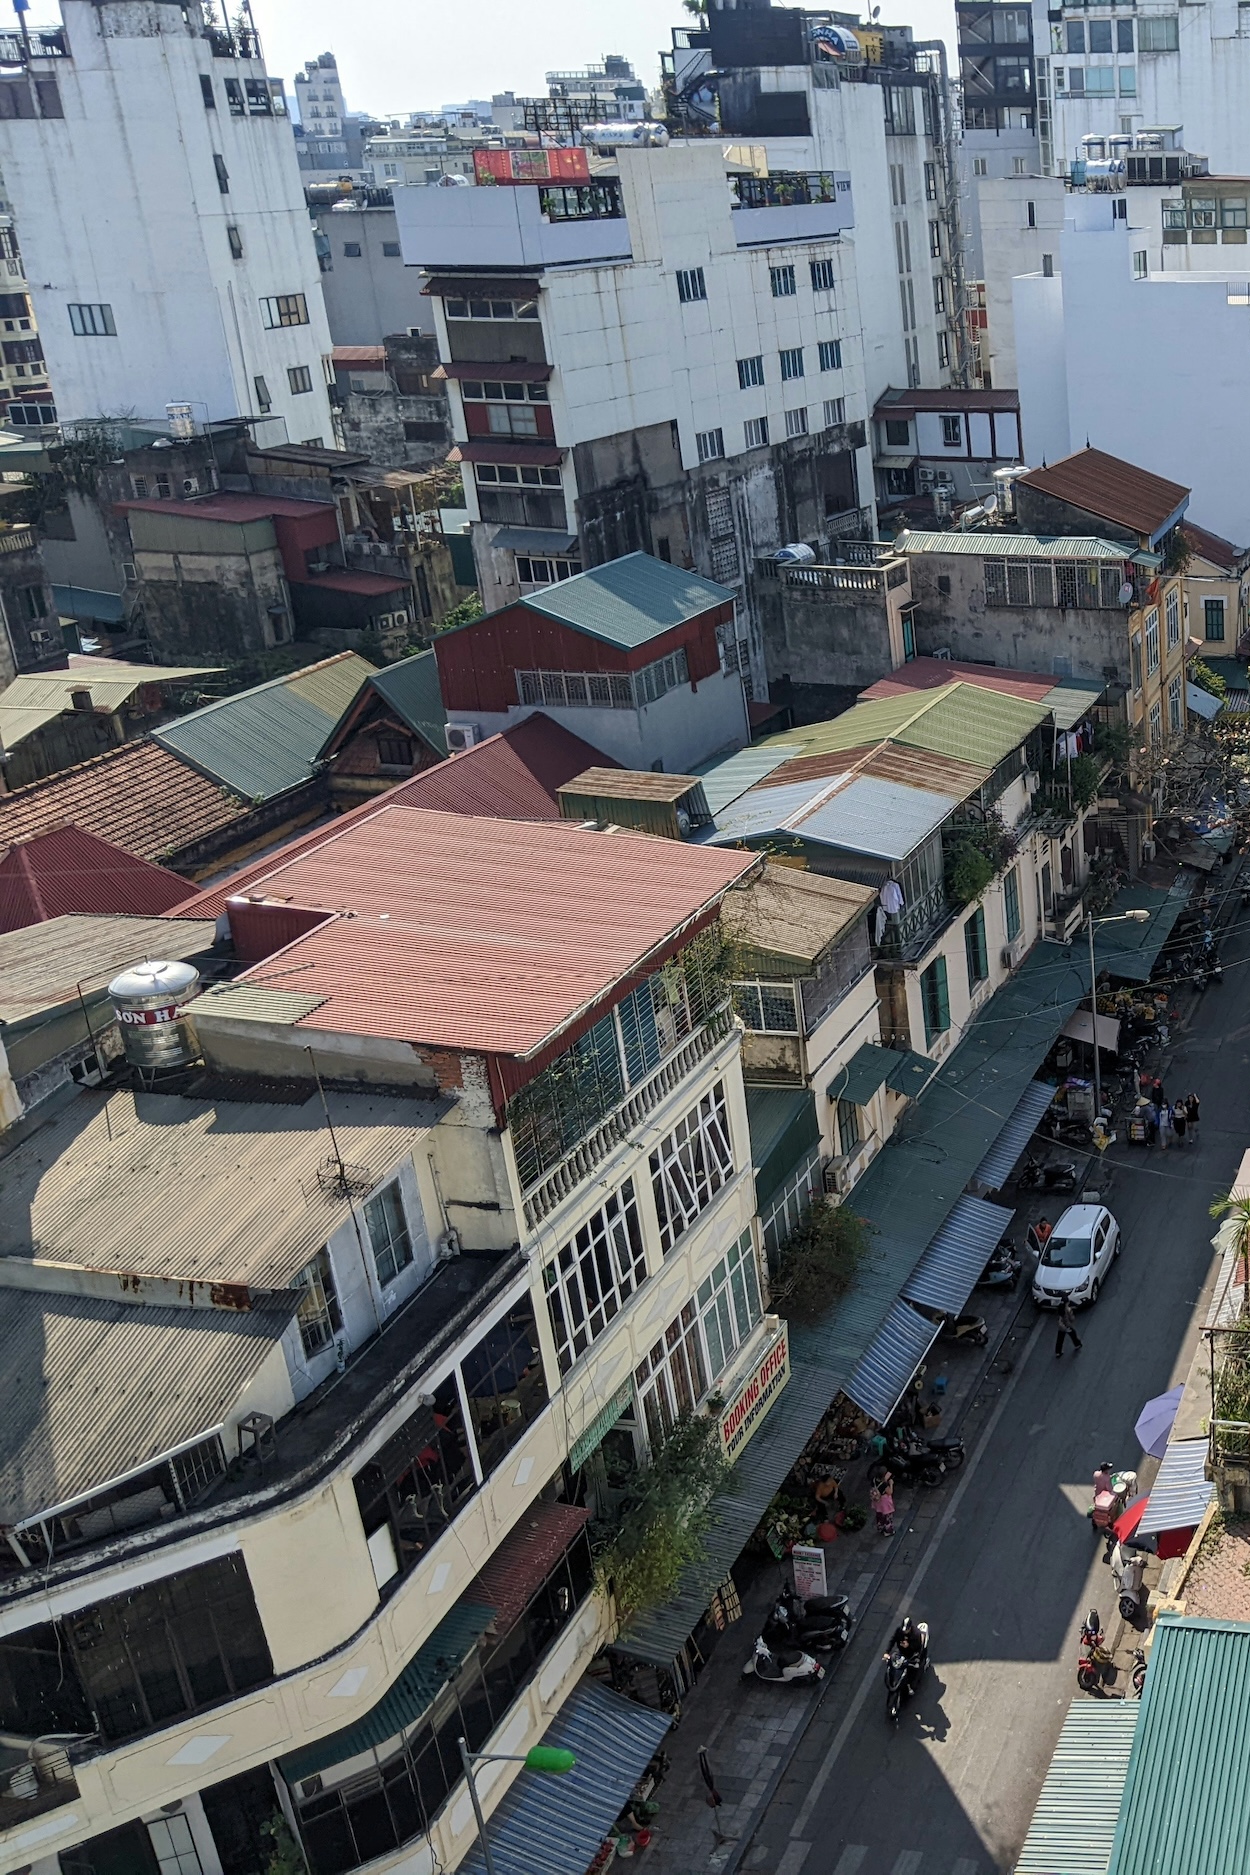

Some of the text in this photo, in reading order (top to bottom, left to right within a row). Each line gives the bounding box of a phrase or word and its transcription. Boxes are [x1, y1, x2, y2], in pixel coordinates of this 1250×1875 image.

[723, 1376, 759, 1442] BOOKING
[760, 1338, 787, 1387] OFFICE
[727, 1425, 744, 1457] TOUR
[744, 1362, 786, 1431] INFORMATION
